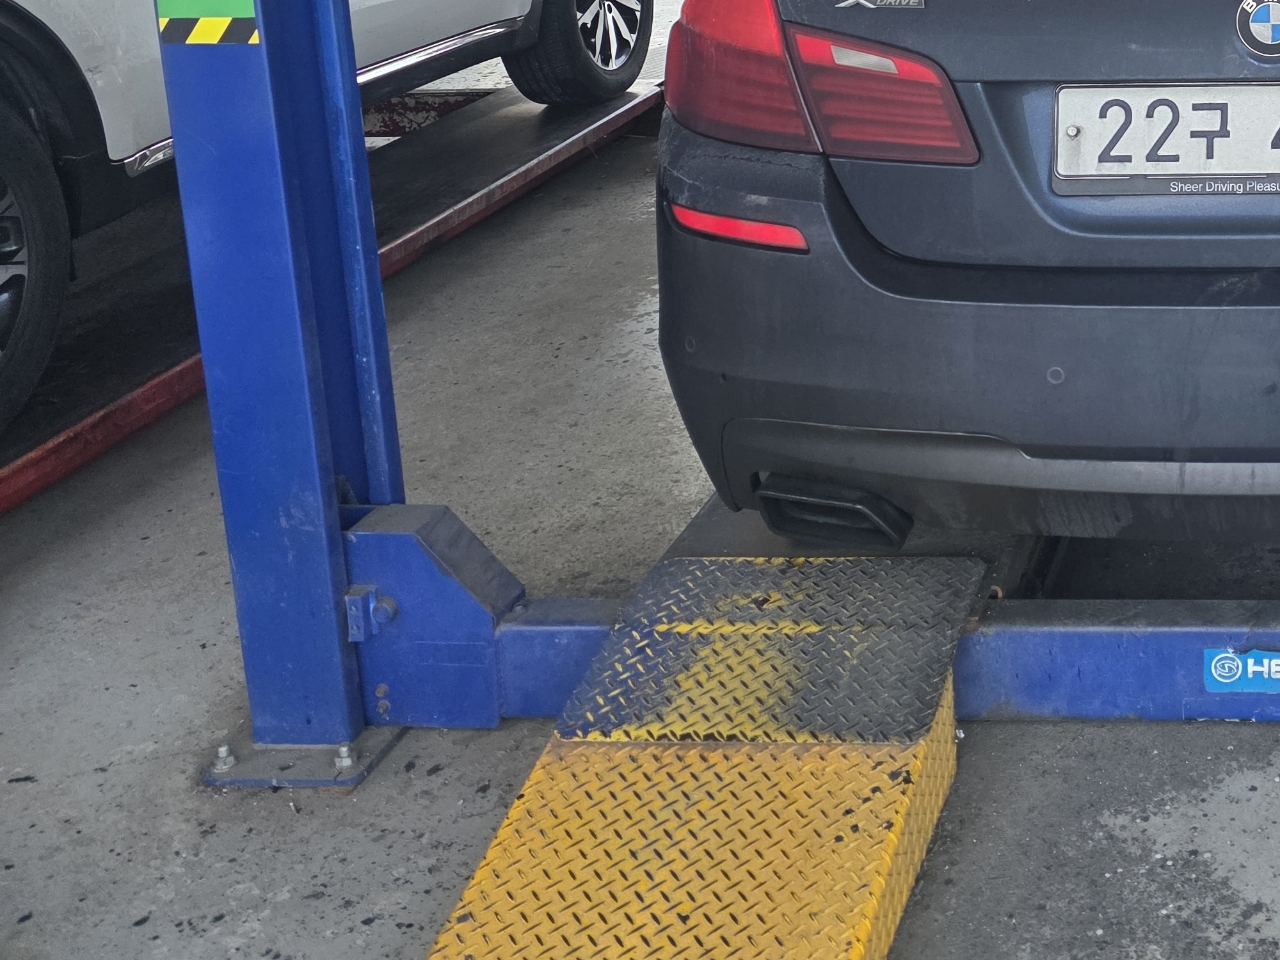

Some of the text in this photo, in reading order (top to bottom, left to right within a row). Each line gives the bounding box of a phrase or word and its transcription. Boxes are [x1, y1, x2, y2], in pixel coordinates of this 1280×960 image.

[1098, 97, 1231, 164] 22구
[1170, 181, 1203, 192] Sheer
[1205, 181, 1244, 194] Driving
